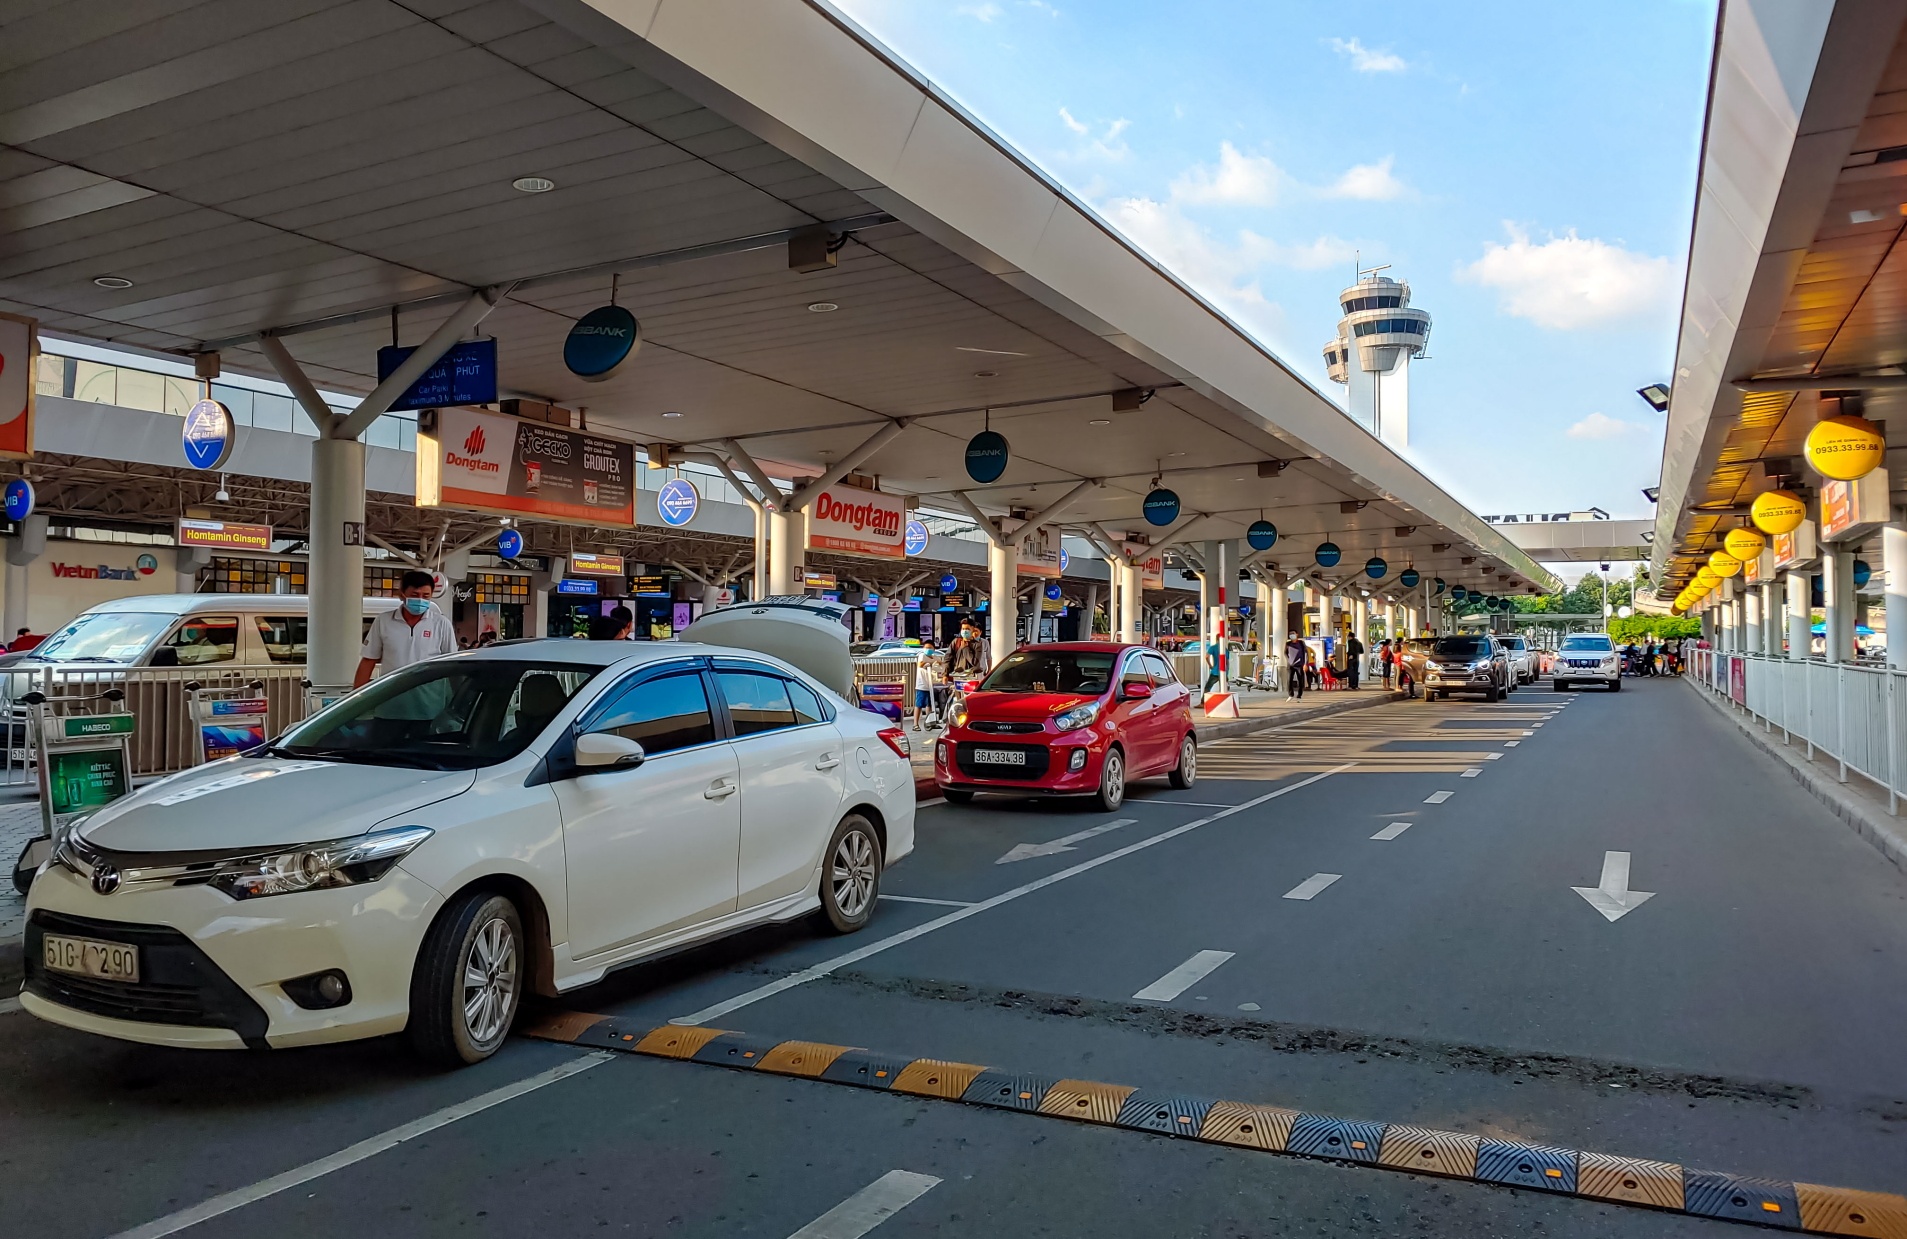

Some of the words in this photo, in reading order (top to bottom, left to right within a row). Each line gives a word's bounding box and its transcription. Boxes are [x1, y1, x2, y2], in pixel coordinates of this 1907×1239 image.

[418, 386, 430, 394] Car
[409, 396, 437, 405] aximum
[532, 437, 571, 459] GECKO
[1815, 443, 1879, 454] 0933.33.99.88
[446, 452, 499, 473] Dongtam
[583, 453, 620, 474] GROUTEX
[607, 474, 621, 482] PRO
[4, 495, 18, 507] VIB
[816, 492, 900, 531] Dongtam
[186, 529, 232, 543] Homtamin
[232, 533, 267, 546] Ginseng
[875, 528, 897, 536] GROUP
[499, 540, 511, 549] VIB
[51, 562, 140, 581] VietinBank
[575, 560, 601, 570] Homtamin
[600, 562, 621, 572] Ginseng
[82, 723, 111, 732] HABECO
[975, 751, 1024, 764] 36A-334.38
[46, 939, 135, 977] 51G-2.90
